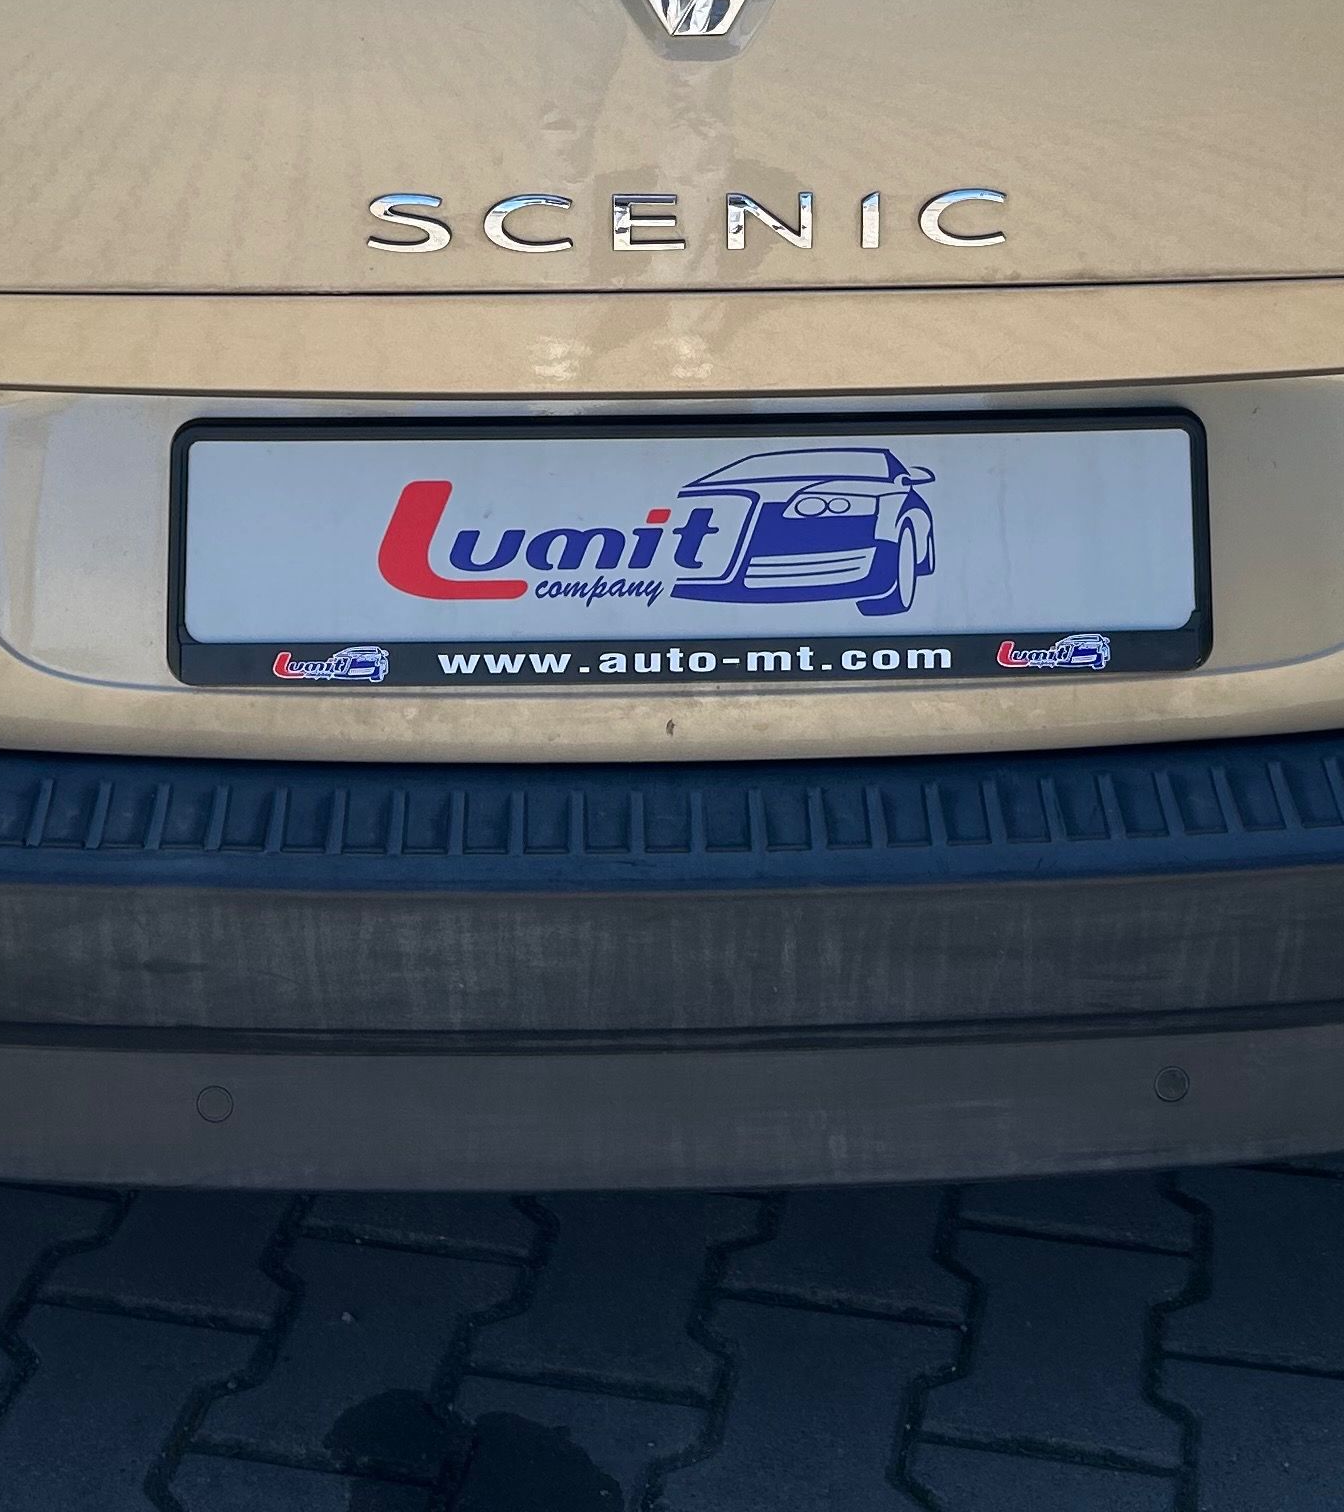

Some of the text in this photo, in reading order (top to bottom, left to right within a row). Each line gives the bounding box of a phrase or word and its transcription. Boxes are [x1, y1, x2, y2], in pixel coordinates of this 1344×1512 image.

[366, 187, 1007, 253] SCENIC
[378, 480, 720, 600] Lumit
[534, 575, 664, 607] company
[437, 645, 953, 675] www.auto-mt.com
